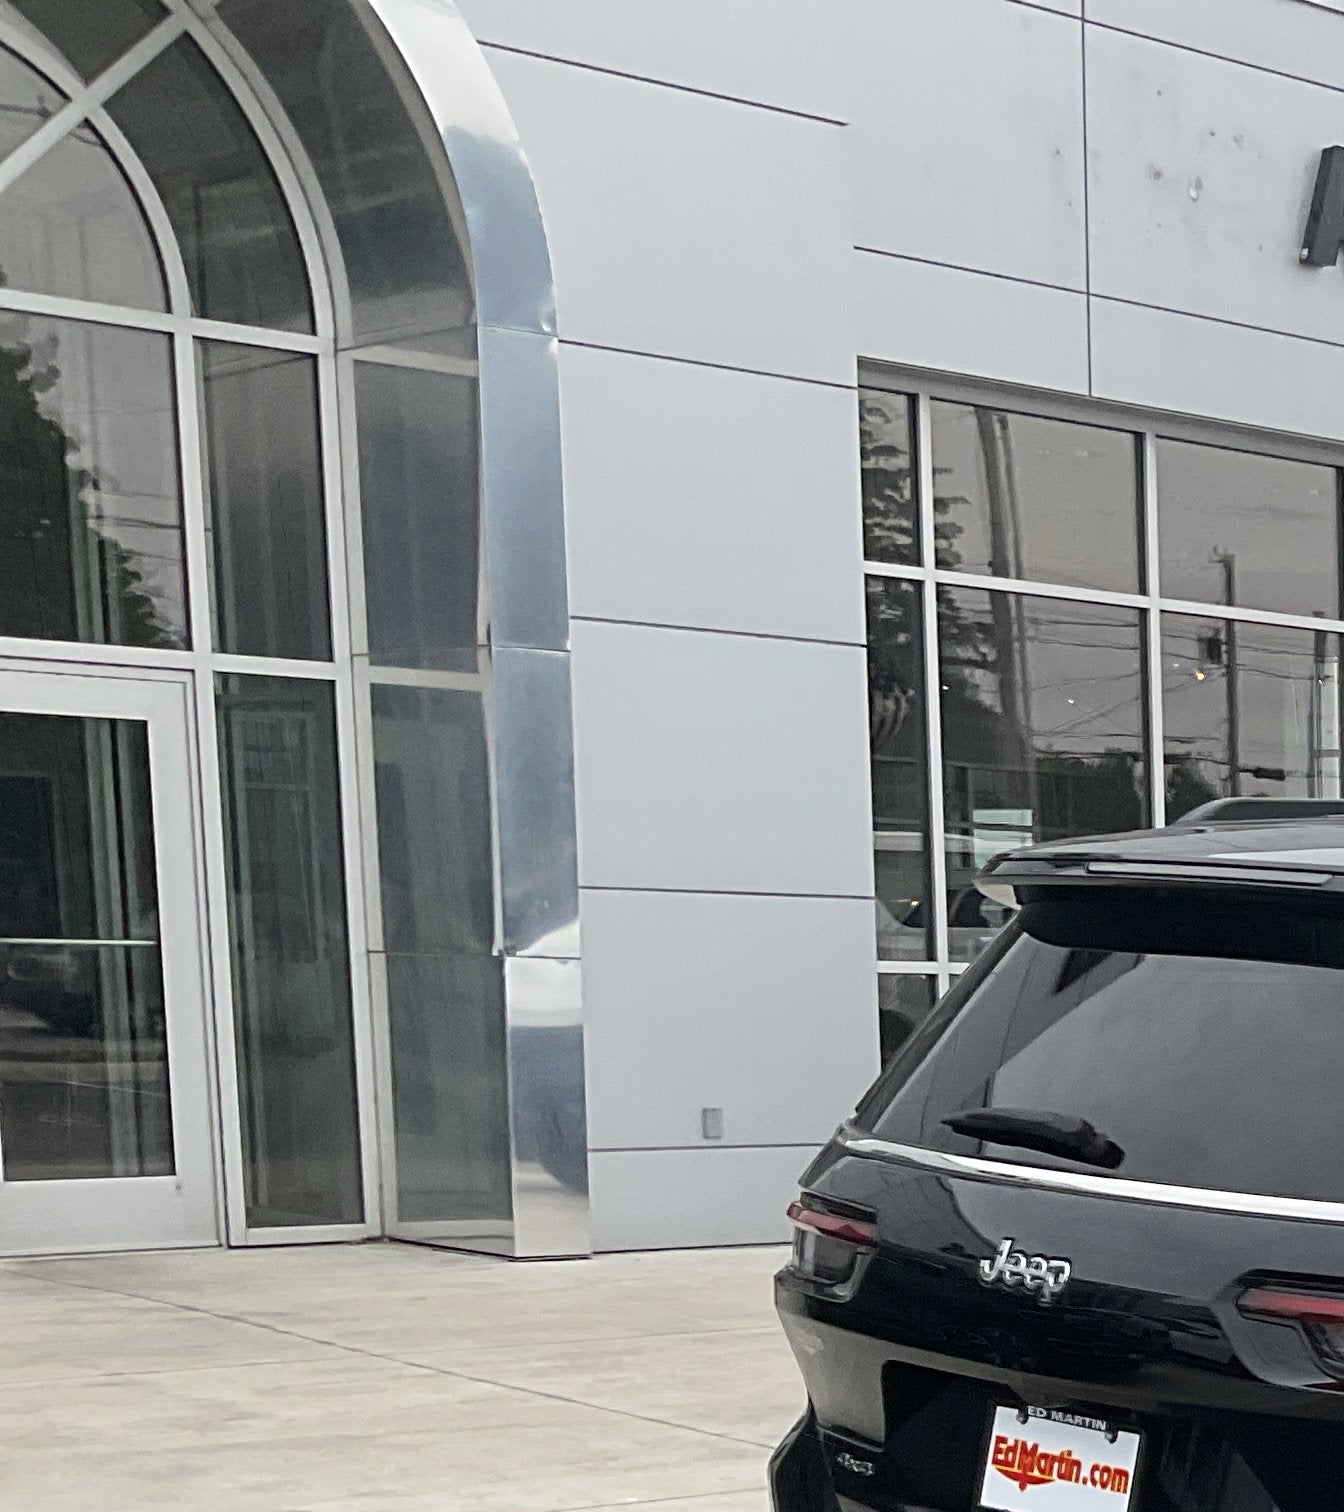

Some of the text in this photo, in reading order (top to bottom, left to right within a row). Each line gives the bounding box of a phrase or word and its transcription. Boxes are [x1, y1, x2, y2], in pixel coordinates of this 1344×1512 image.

[979, 1239, 1071, 1306] Jeep
[1027, 1405, 1107, 1431] ED MARTIN
[991, 1434, 1130, 1495] EdMartin.com
